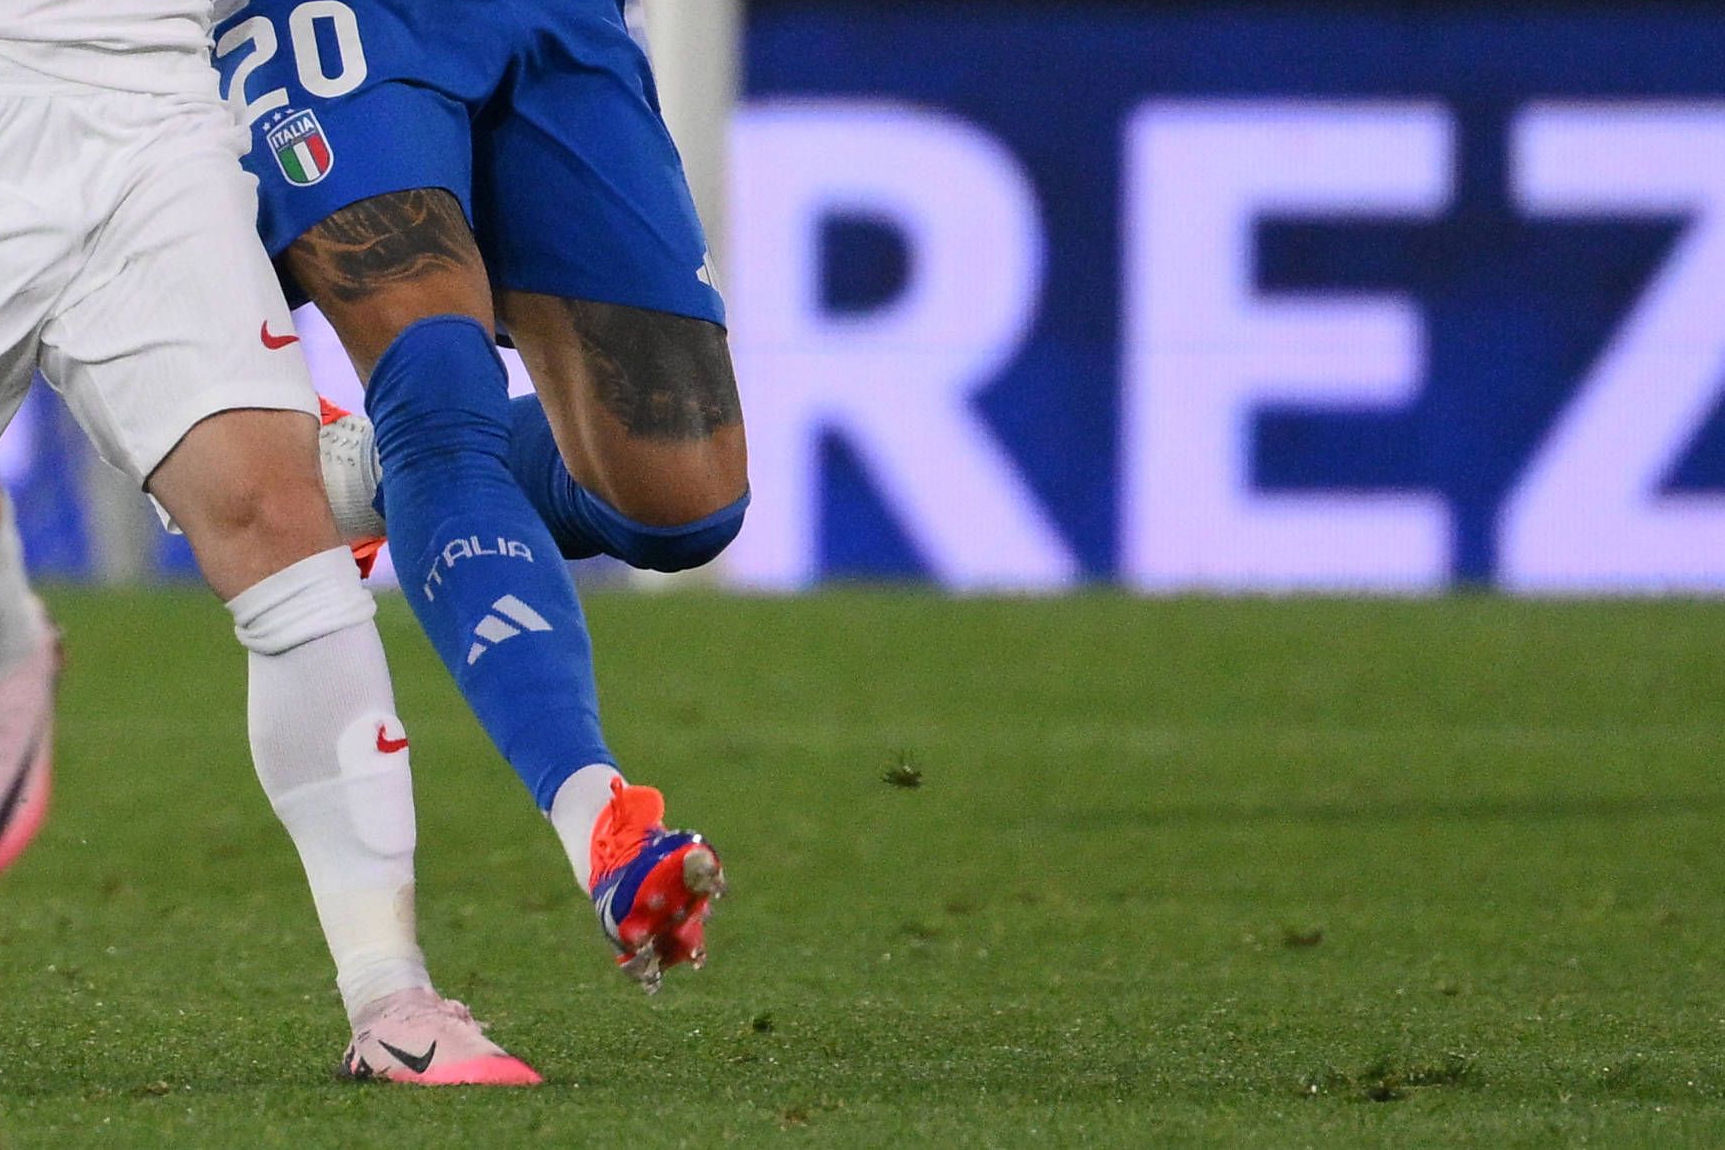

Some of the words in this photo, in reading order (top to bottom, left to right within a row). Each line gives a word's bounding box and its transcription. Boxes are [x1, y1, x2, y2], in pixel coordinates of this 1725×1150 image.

[212, 0, 368, 123] 20
[271, 117, 315, 150] ITALIA
[422, 535, 535, 603] ITALIA
